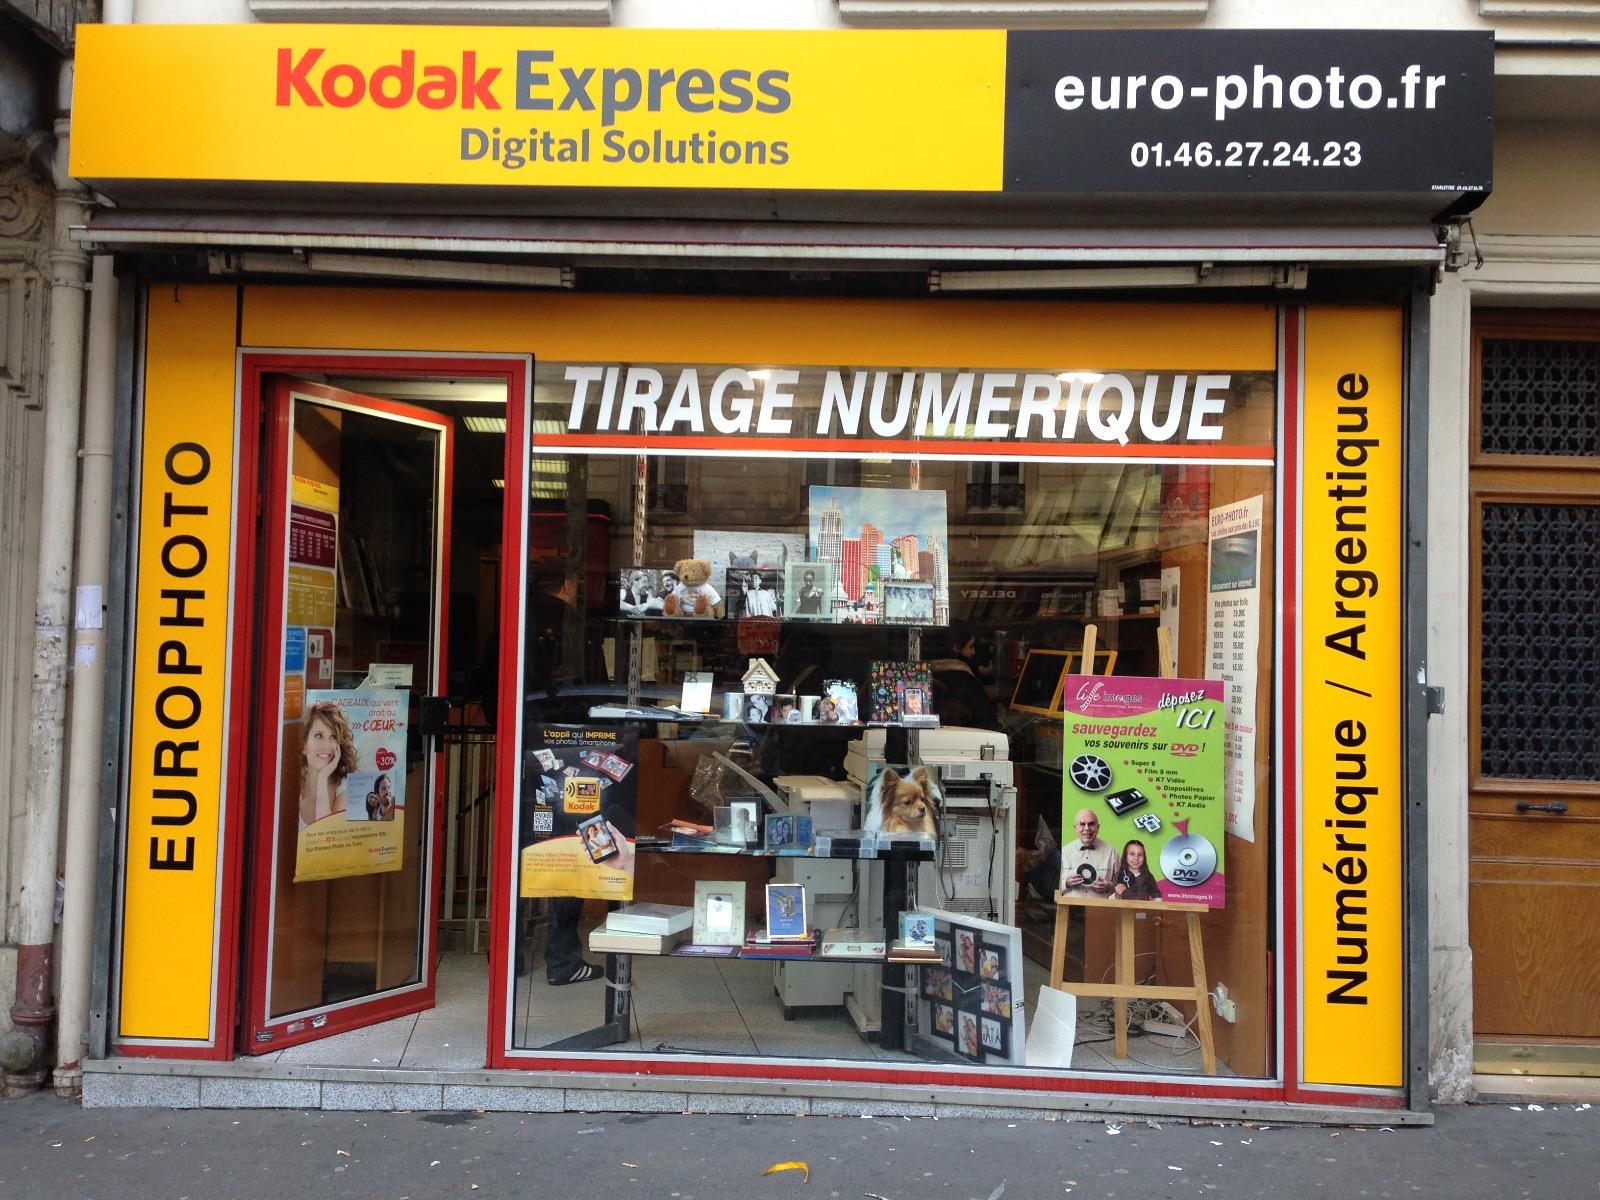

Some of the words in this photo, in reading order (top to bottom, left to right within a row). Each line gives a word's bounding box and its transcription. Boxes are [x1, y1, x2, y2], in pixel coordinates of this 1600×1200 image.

[276, 48, 503, 110] Kodak
[515, 50, 791, 127] Express
[1054, 64, 1446, 120] euro-photo.fr
[460, 127, 590, 170] Digital
[603, 129, 789, 166] Solutions
[1130, 142, 1362, 167] 01.46.27.24.23
[564, 366, 799, 434] TIRAGE
[816, 370, 1232, 447] NUMERIQUE
[1324, 372, 1379, 661] Argentique
[149, 441, 211, 870] EUROPHOTO
[1324, 680, 1372, 698] /
[370, 699, 382, 708] qui
[383, 698, 399, 706] vont
[1158, 689, 1205, 711] déposez
[369, 709, 384, 717] droit
[1175, 708, 1214, 729] ICI
[544, 730, 570, 739] L'appli
[585, 731, 616, 740] IMPRIME
[1072, 723, 1157, 739] sauvegardez
[579, 739, 616, 747] Smartphone
[1085, 740, 1101, 748] vos
[1103, 740, 1149, 750] souvenirs
[1152, 741, 1168, 751] sur
[1170, 743, 1199, 754] DVD
[568, 802, 595, 811] Kodak
[1322, 719, 1378, 1007] Numérique
[1173, 869, 1199, 879] DVD
